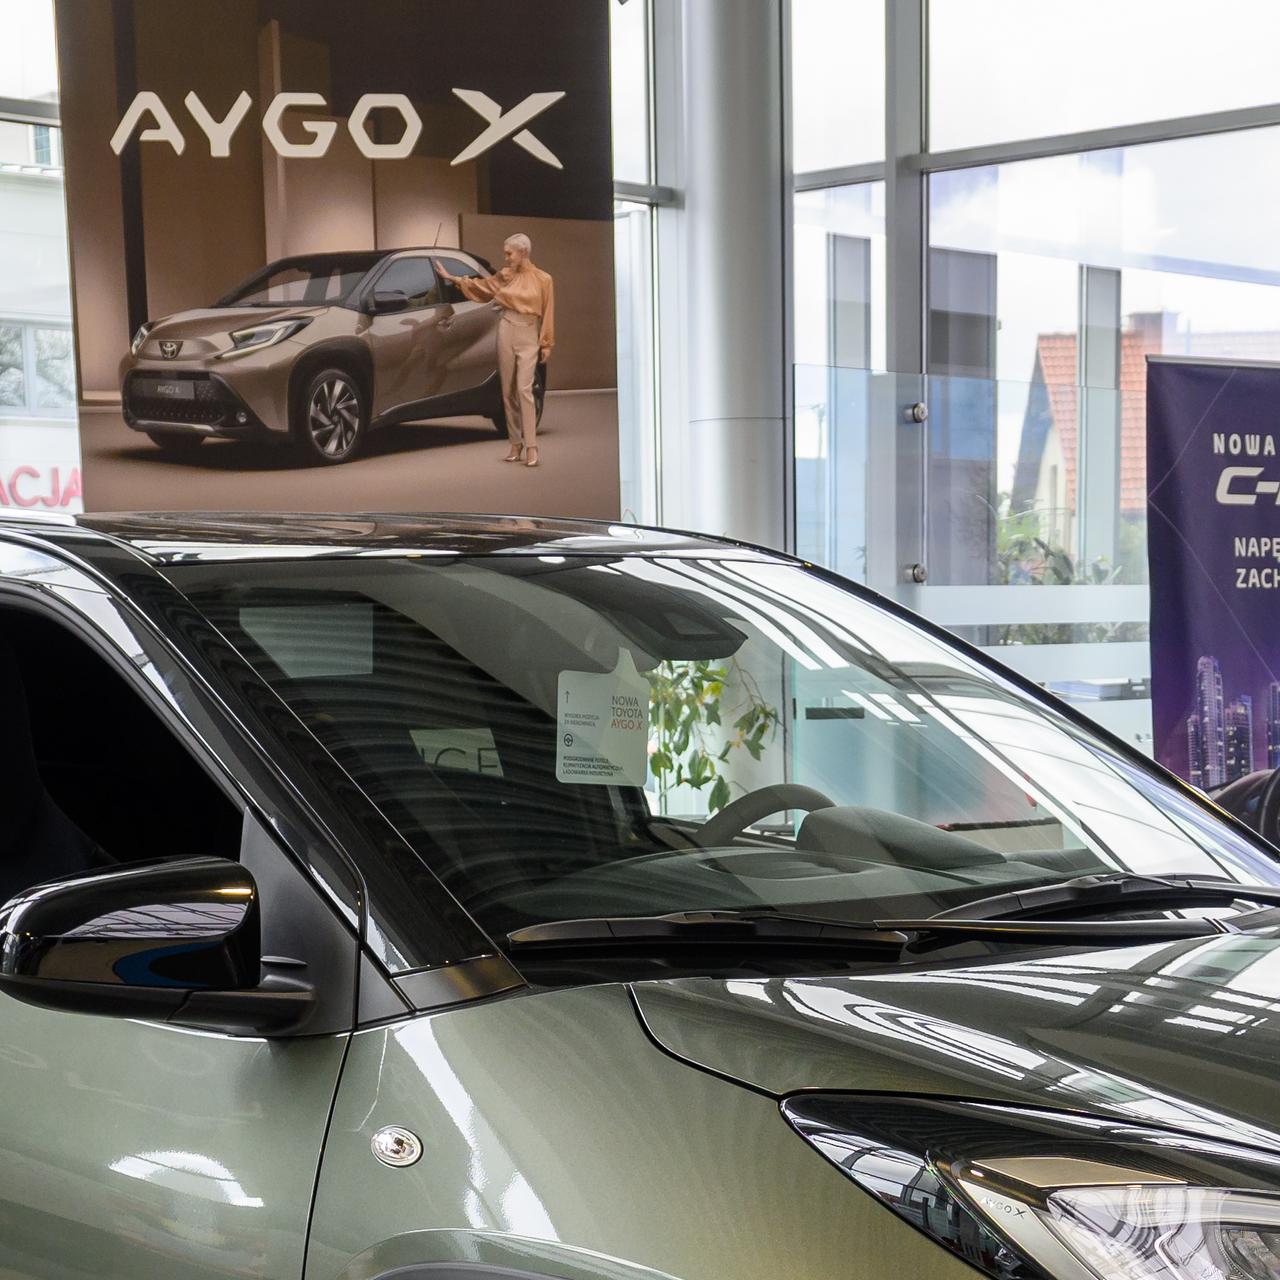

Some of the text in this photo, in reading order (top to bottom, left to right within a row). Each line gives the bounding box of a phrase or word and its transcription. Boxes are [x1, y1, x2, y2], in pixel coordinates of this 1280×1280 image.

[110, 87, 566, 170] AYGO X
[1213, 433, 1276, 456] NOWA
[611, 696, 639, 707] NOWA
[611, 707, 643, 719] TOYOTA
[611, 719, 643, 731] AYGO X
